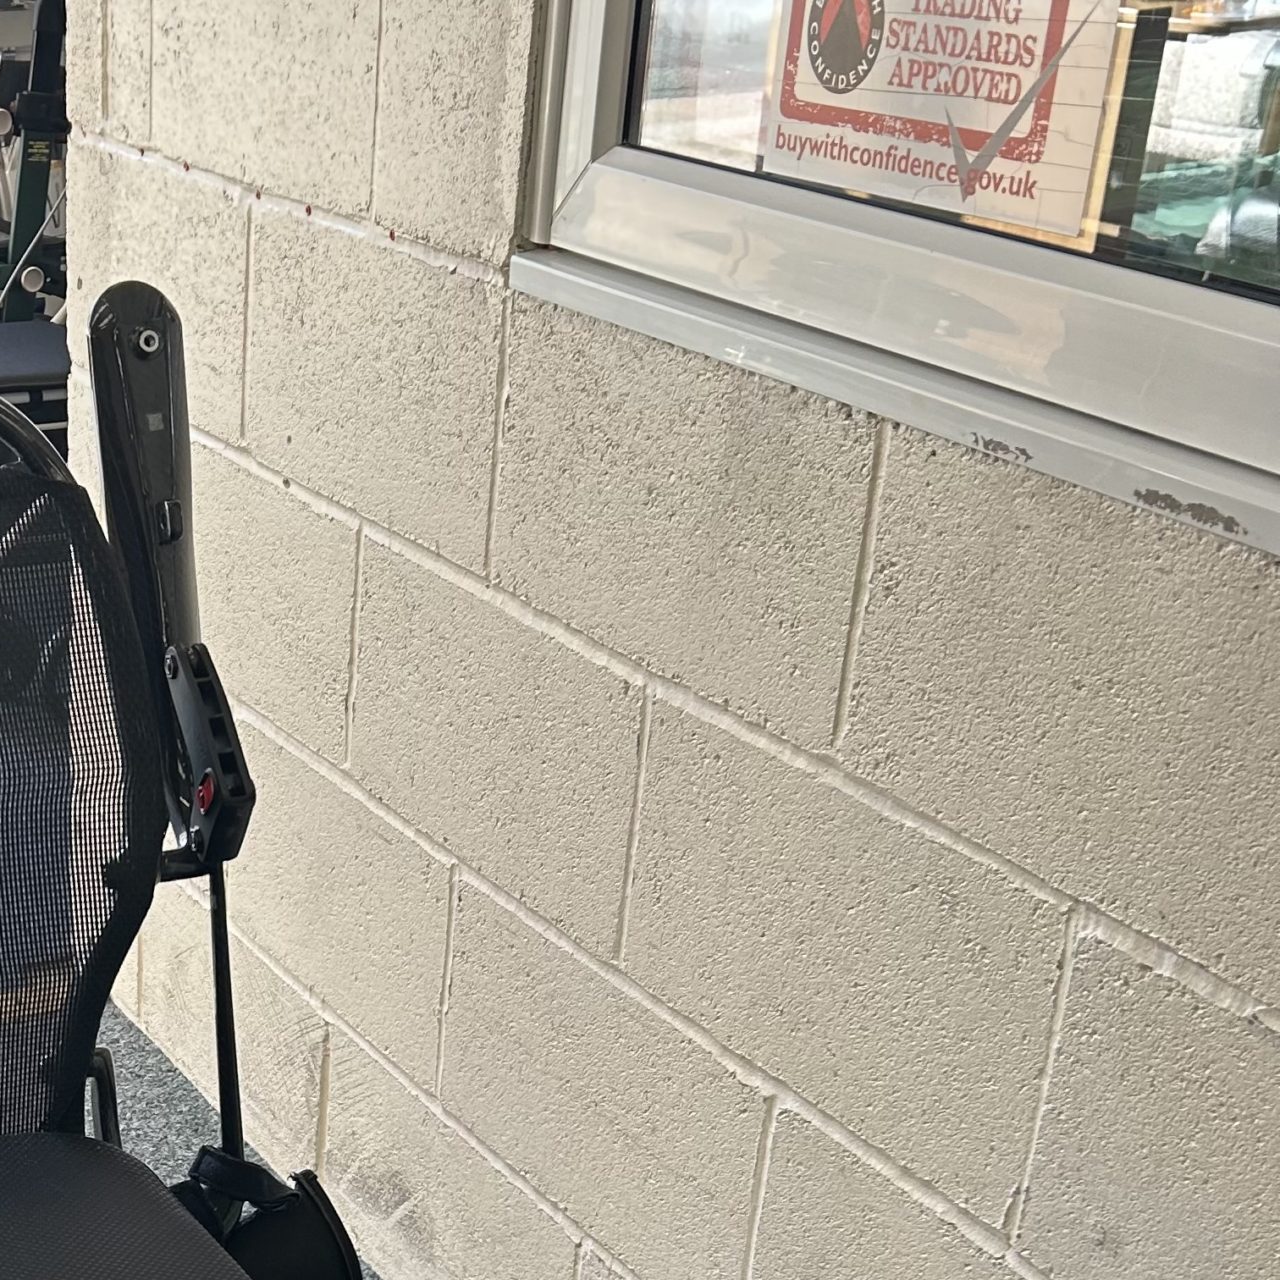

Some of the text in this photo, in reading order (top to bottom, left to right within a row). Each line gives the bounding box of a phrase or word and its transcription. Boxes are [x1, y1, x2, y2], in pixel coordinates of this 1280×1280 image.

[809, 21, 881, 89] CONFIDENCE
[885, 17, 1038, 69] STANDARDS
[887, 56, 1023, 106] APPROVED
[775, 124, 1039, 200] buywithconfidence.gov.uk
